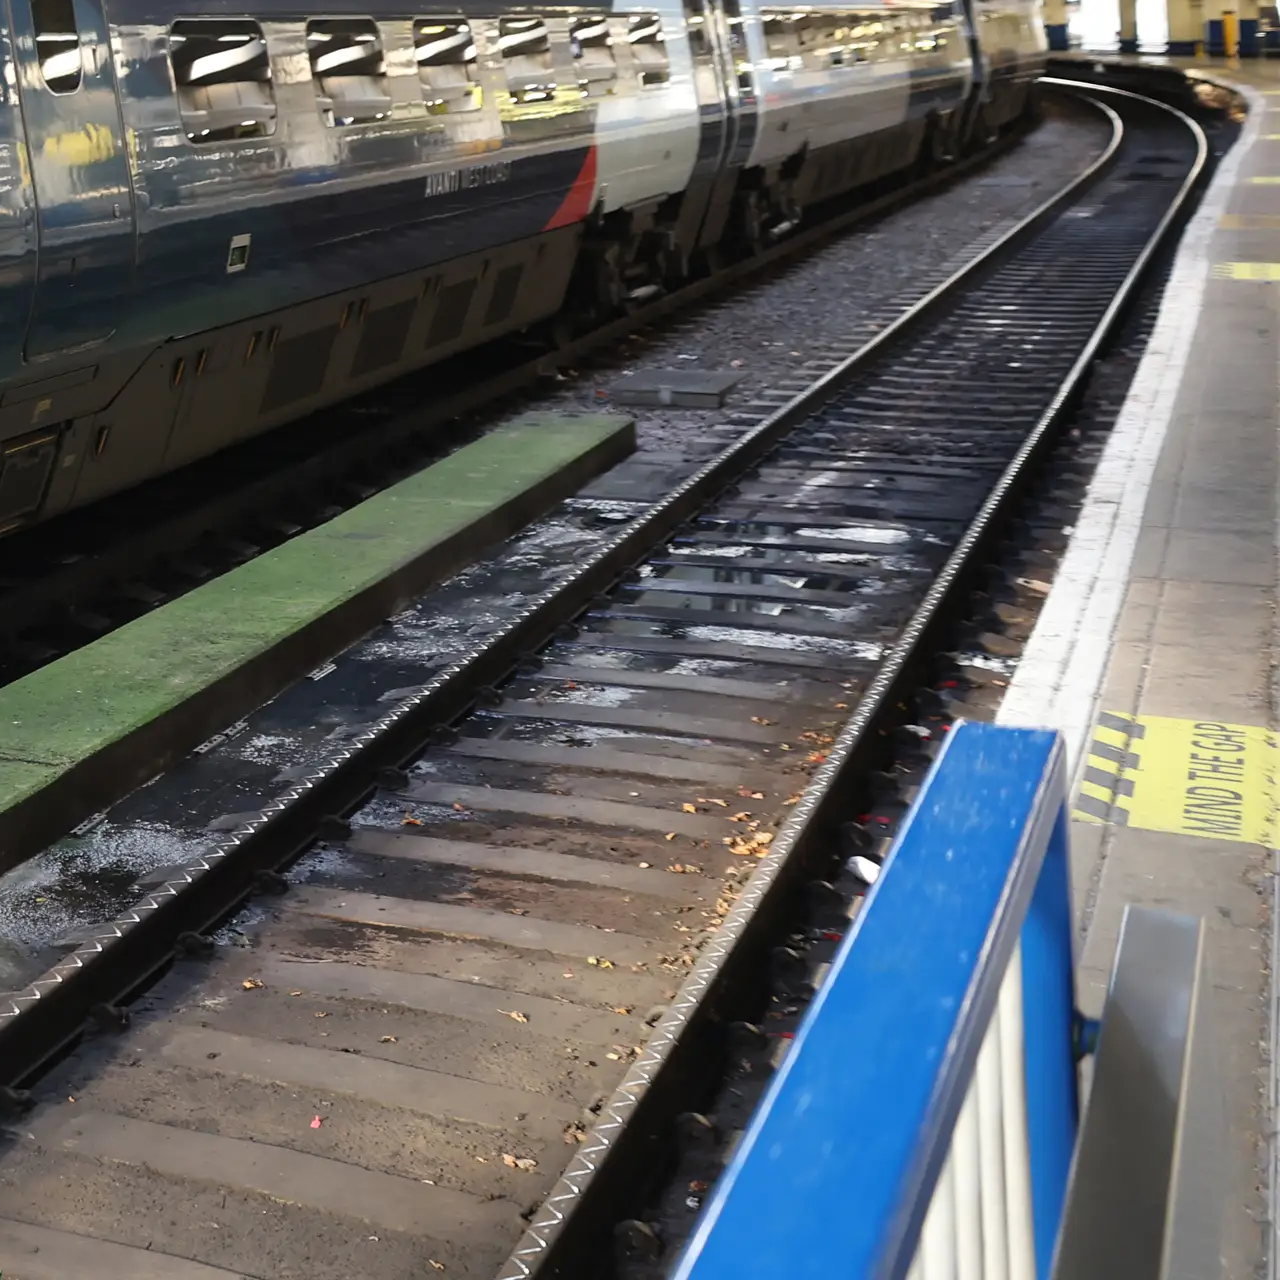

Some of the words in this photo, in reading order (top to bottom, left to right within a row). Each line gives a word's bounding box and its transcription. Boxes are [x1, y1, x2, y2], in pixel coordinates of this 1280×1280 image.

[1191, 723, 1246, 752] GAP
[1188, 752, 1245, 782] THE
[1182, 786, 1243, 836] MIND
